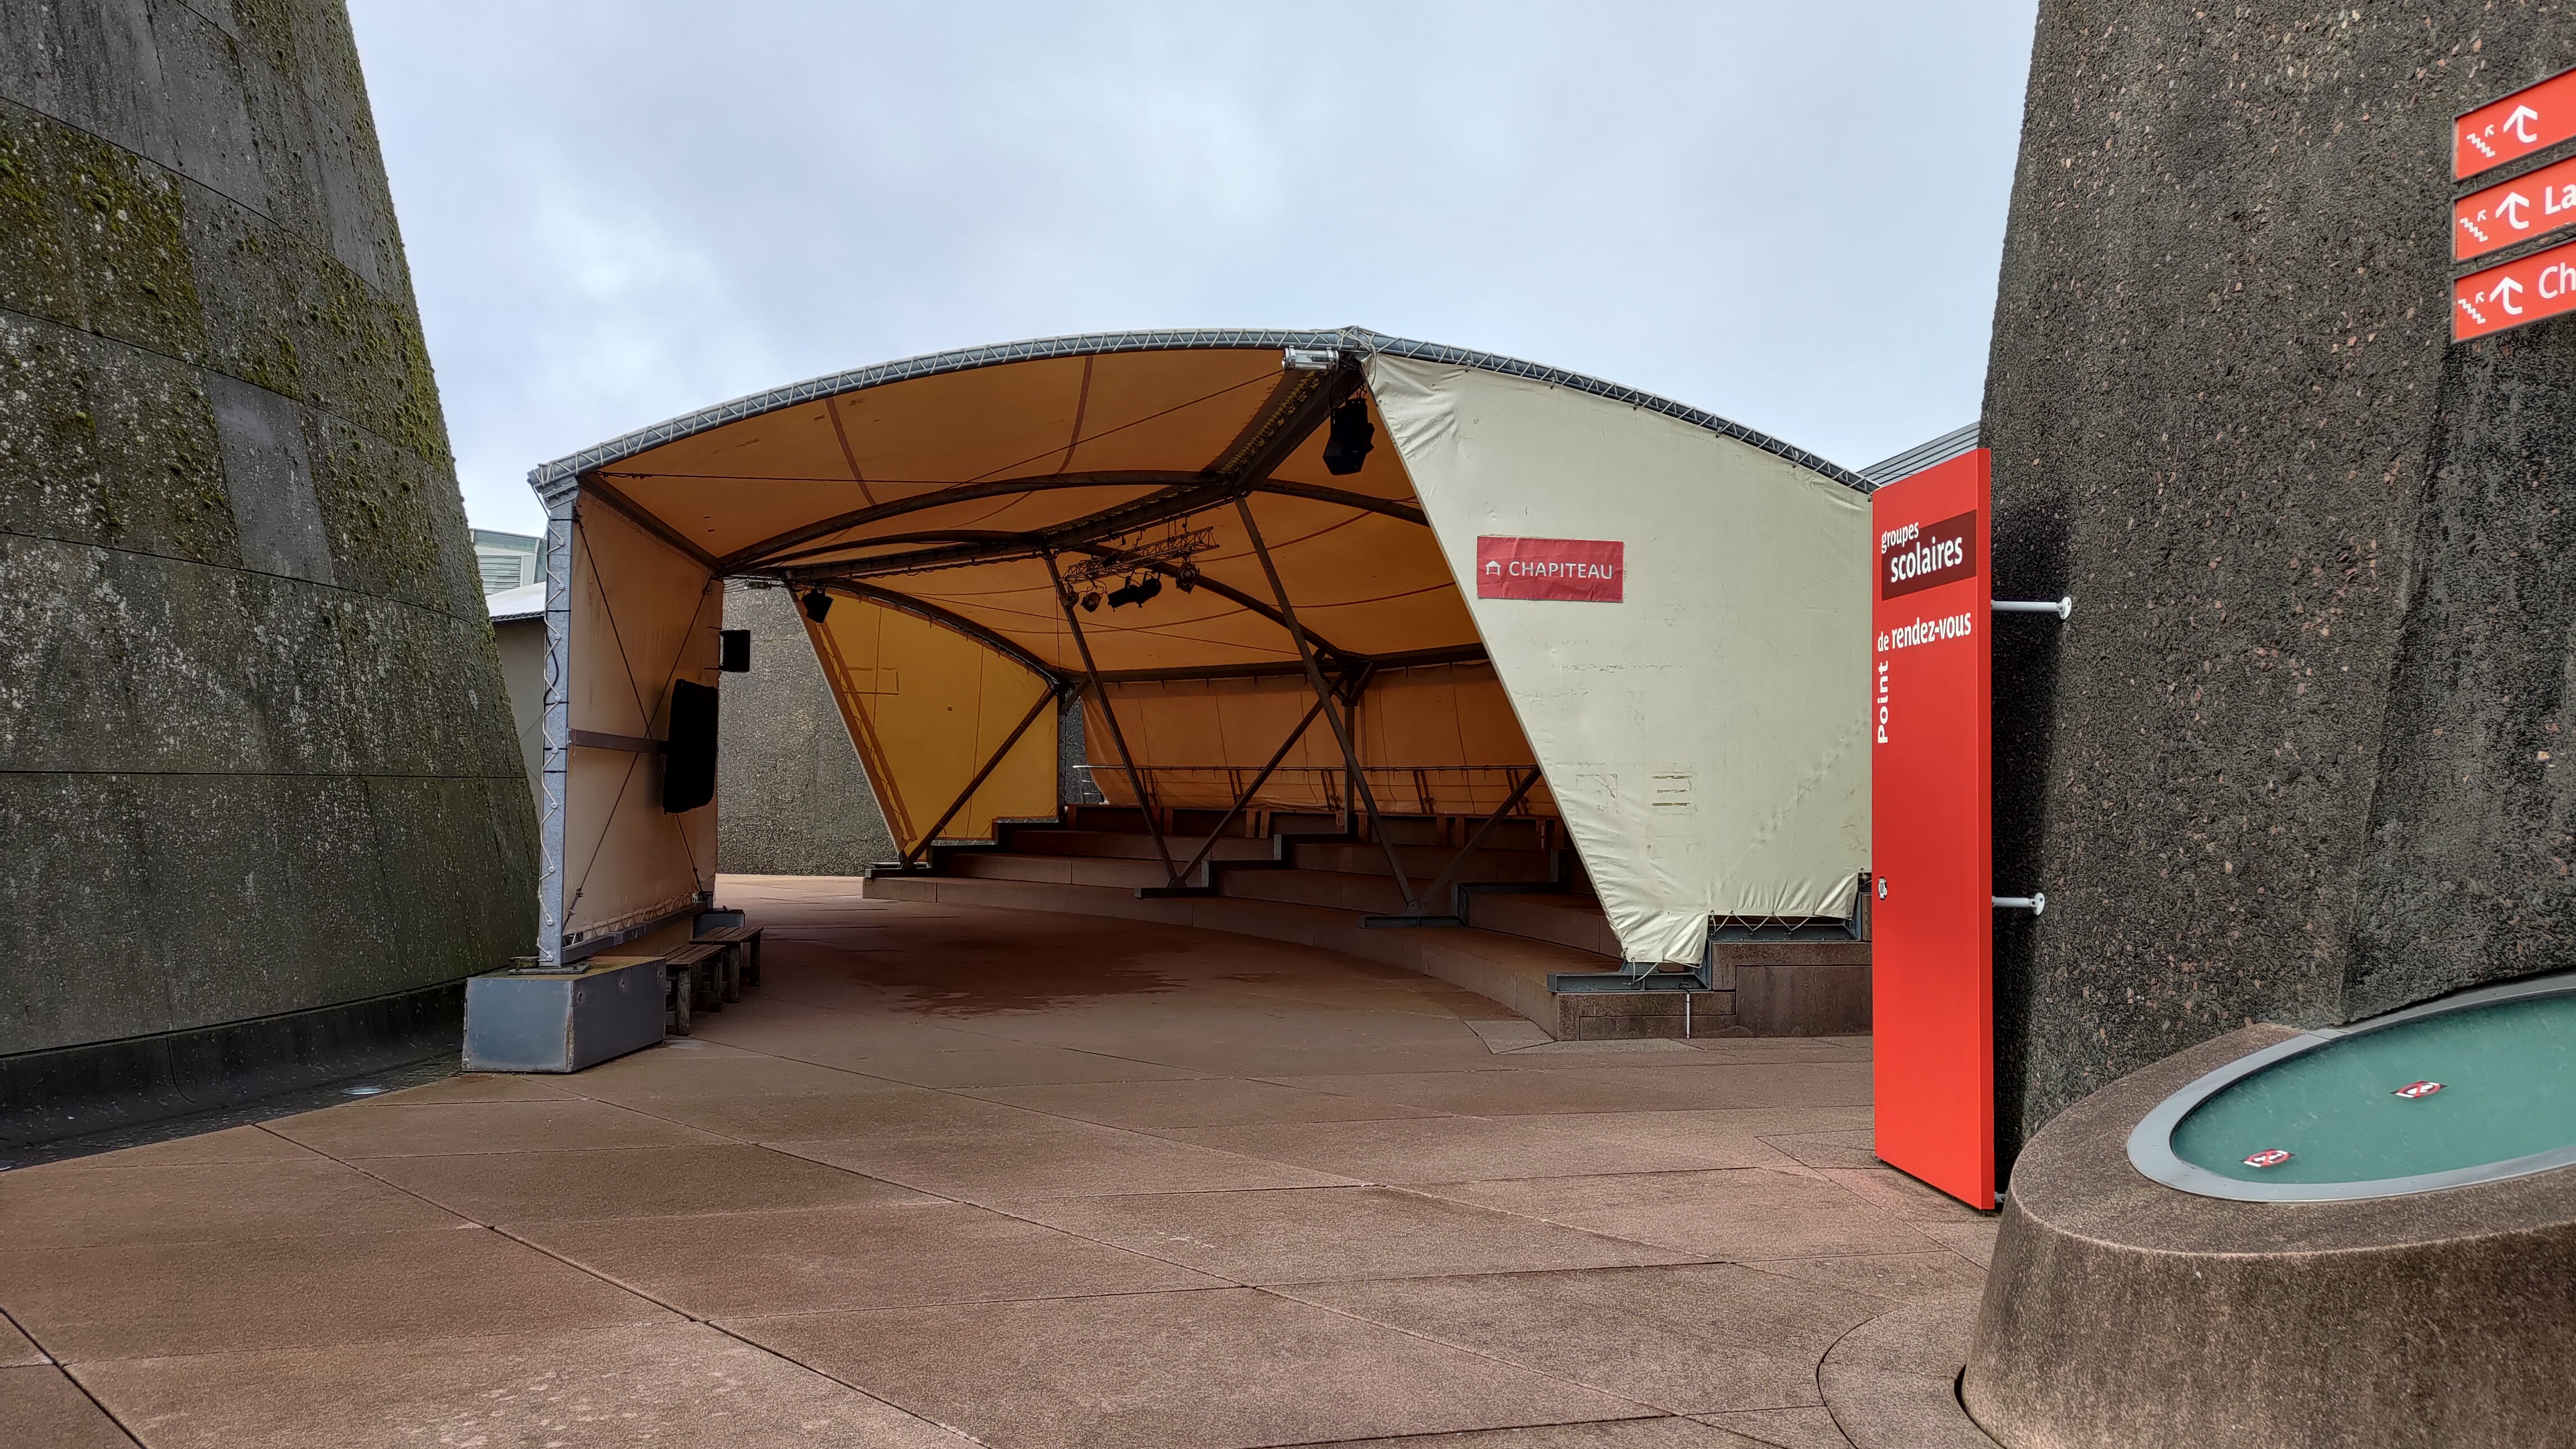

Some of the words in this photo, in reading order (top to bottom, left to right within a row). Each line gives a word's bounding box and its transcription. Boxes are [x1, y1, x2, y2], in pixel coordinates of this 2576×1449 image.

[2545, 184, 2576, 215] La
[2538, 262, 2576, 299] Ch
[1881, 521, 1920, 554] groupes
[1509, 560, 1613, 579] CHAPITEAU
[1890, 536, 1963, 583] scolaires
[1877, 630, 1890, 652] de
[1891, 612, 1972, 650] rendez-vous
[1877, 660, 1889, 744] Point
